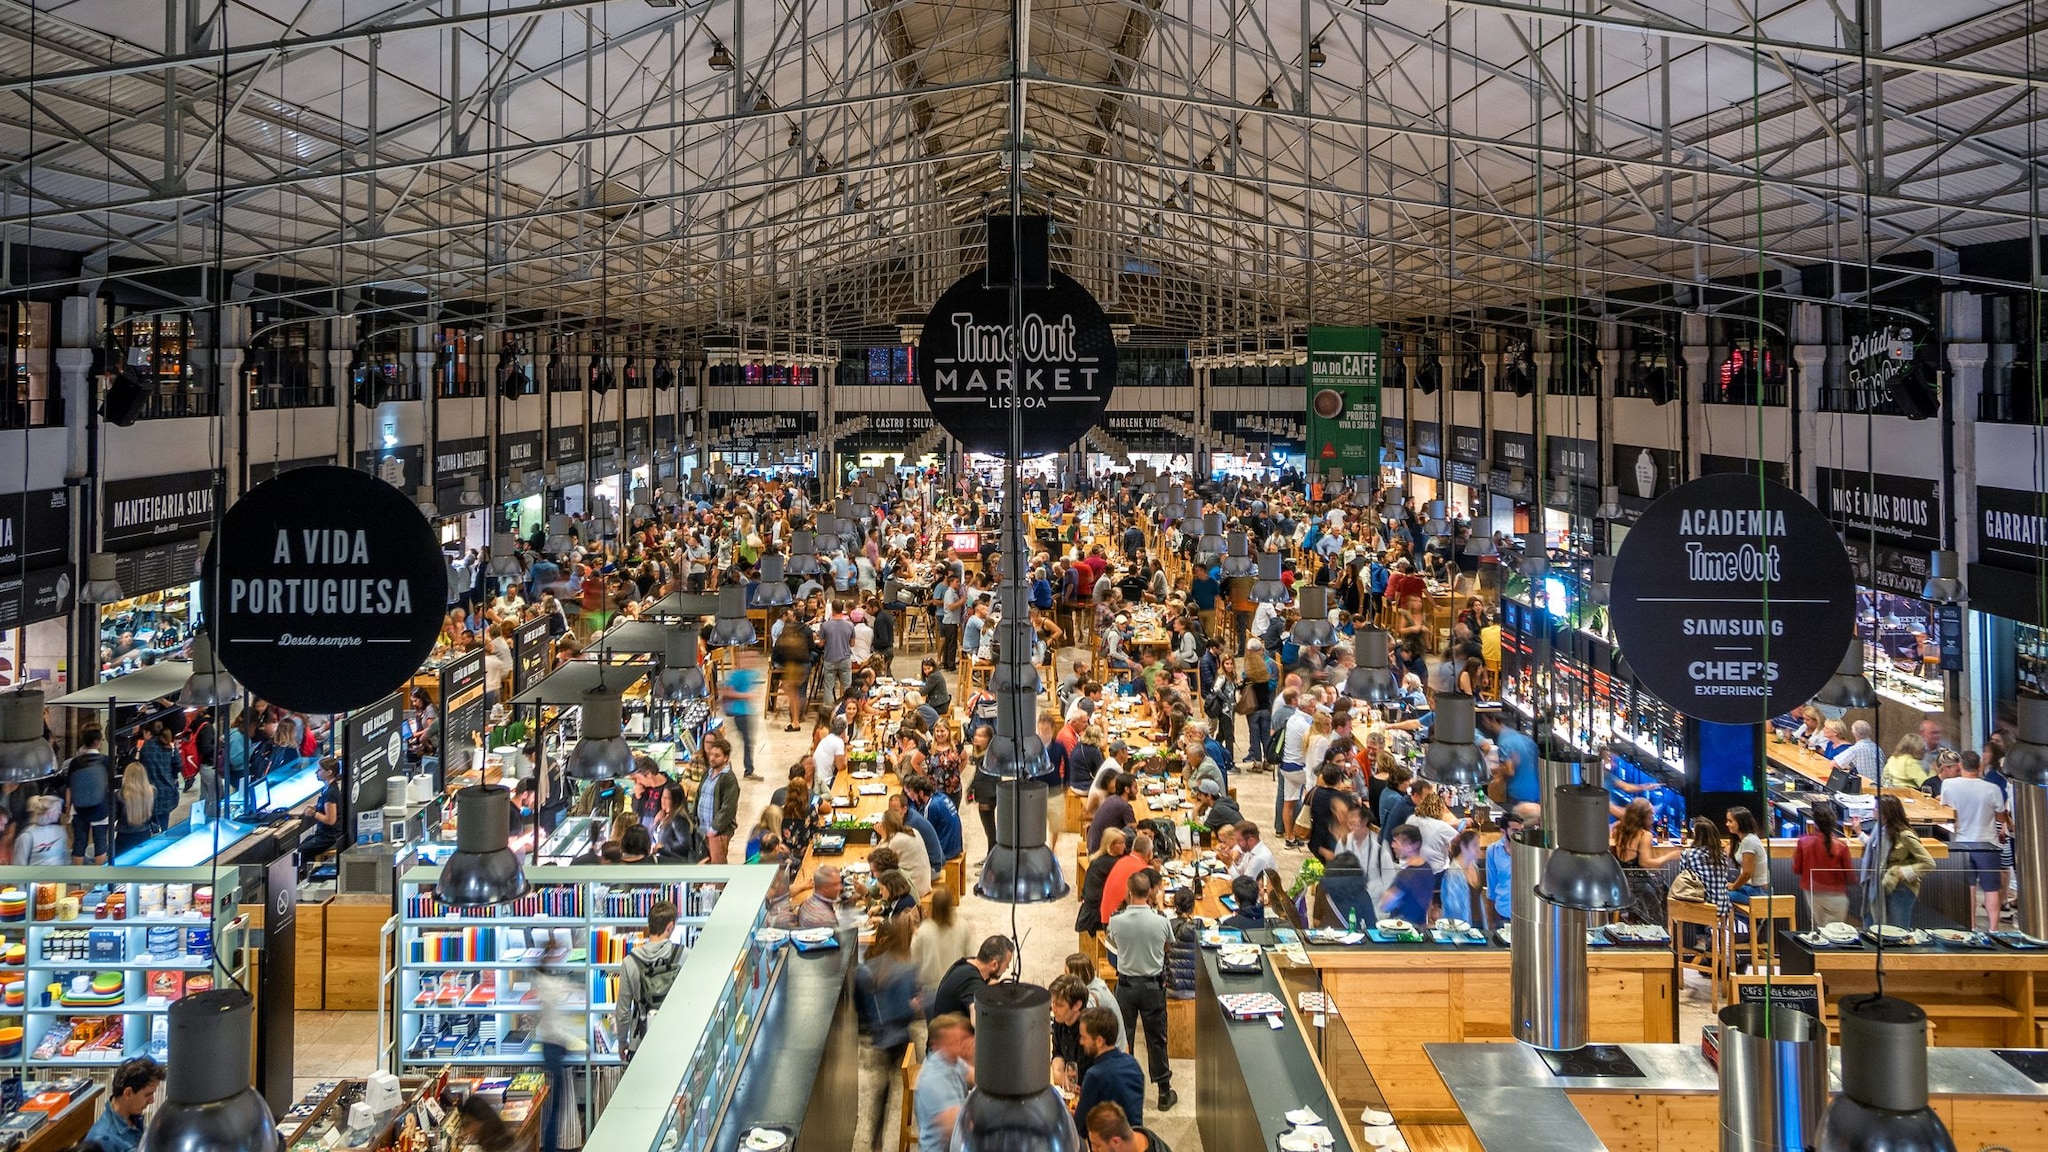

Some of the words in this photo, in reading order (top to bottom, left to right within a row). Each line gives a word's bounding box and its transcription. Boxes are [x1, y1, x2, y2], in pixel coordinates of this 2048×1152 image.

[1312, 361, 1328, 374] DIA
[1329, 362, 1341, 374] DO
[935, 368, 1099, 391] MARKET
[989, 396, 1046, 409] LISBOA
[876, 418, 904, 428] CASTRO
[906, 418, 910, 428] E
[913, 418, 934, 428] SILVA
[1109, 418, 1143, 428] MARLENE
[1346, 412, 1376, 420] PROJECTO
[1339, 421, 1351, 429] VIVA
[1356, 422, 1376, 430] SAMBA
[1562, 450, 1585, 468] HOORTO
[114, 492, 184, 528] MANTEIGARIA
[187, 488, 214, 516] SILVA
[1854, 486, 1860, 516] É
[1864, 492, 1890, 520] MAIS
[1892, 496, 1928, 526] BOLOS
[1679, 509, 1787, 536] ACADEMIA
[273, 528, 292, 564] A
[302, 529, 370, 564] VIDA
[230, 578, 412, 614] PORTUGUESA
[1683, 618, 1784, 636] SAMSUNG
[278, 633, 317, 646] Desde
[316, 635, 362, 648] sempre
[1688, 661, 1779, 682] CHEF'S
[1694, 686, 1773, 696] EXPERIENCE
